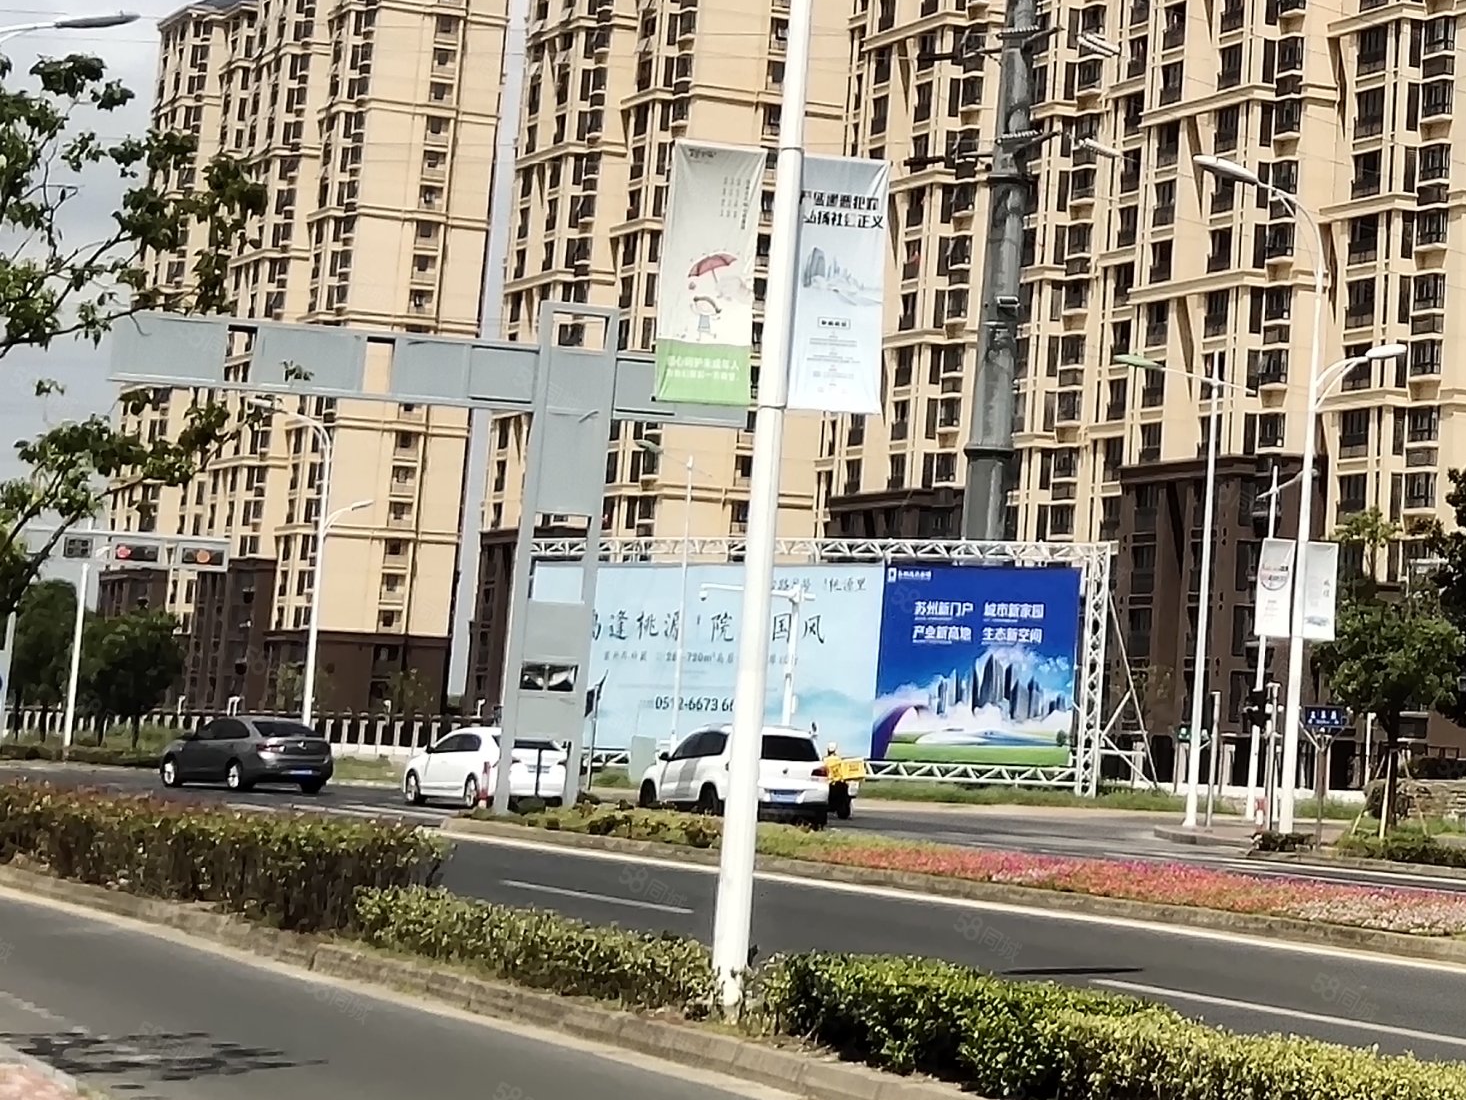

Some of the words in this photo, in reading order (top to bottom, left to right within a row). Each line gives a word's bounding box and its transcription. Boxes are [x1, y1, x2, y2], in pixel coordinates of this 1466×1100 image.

[914, 601, 973, 617] 苏州新门户
[984, 602, 1044, 619] 城市新家园
[711, 611, 825, 644] 院国风
[912, 625, 972, 642] 产业新高地
[982, 627, 1042, 643] 生态新空间
